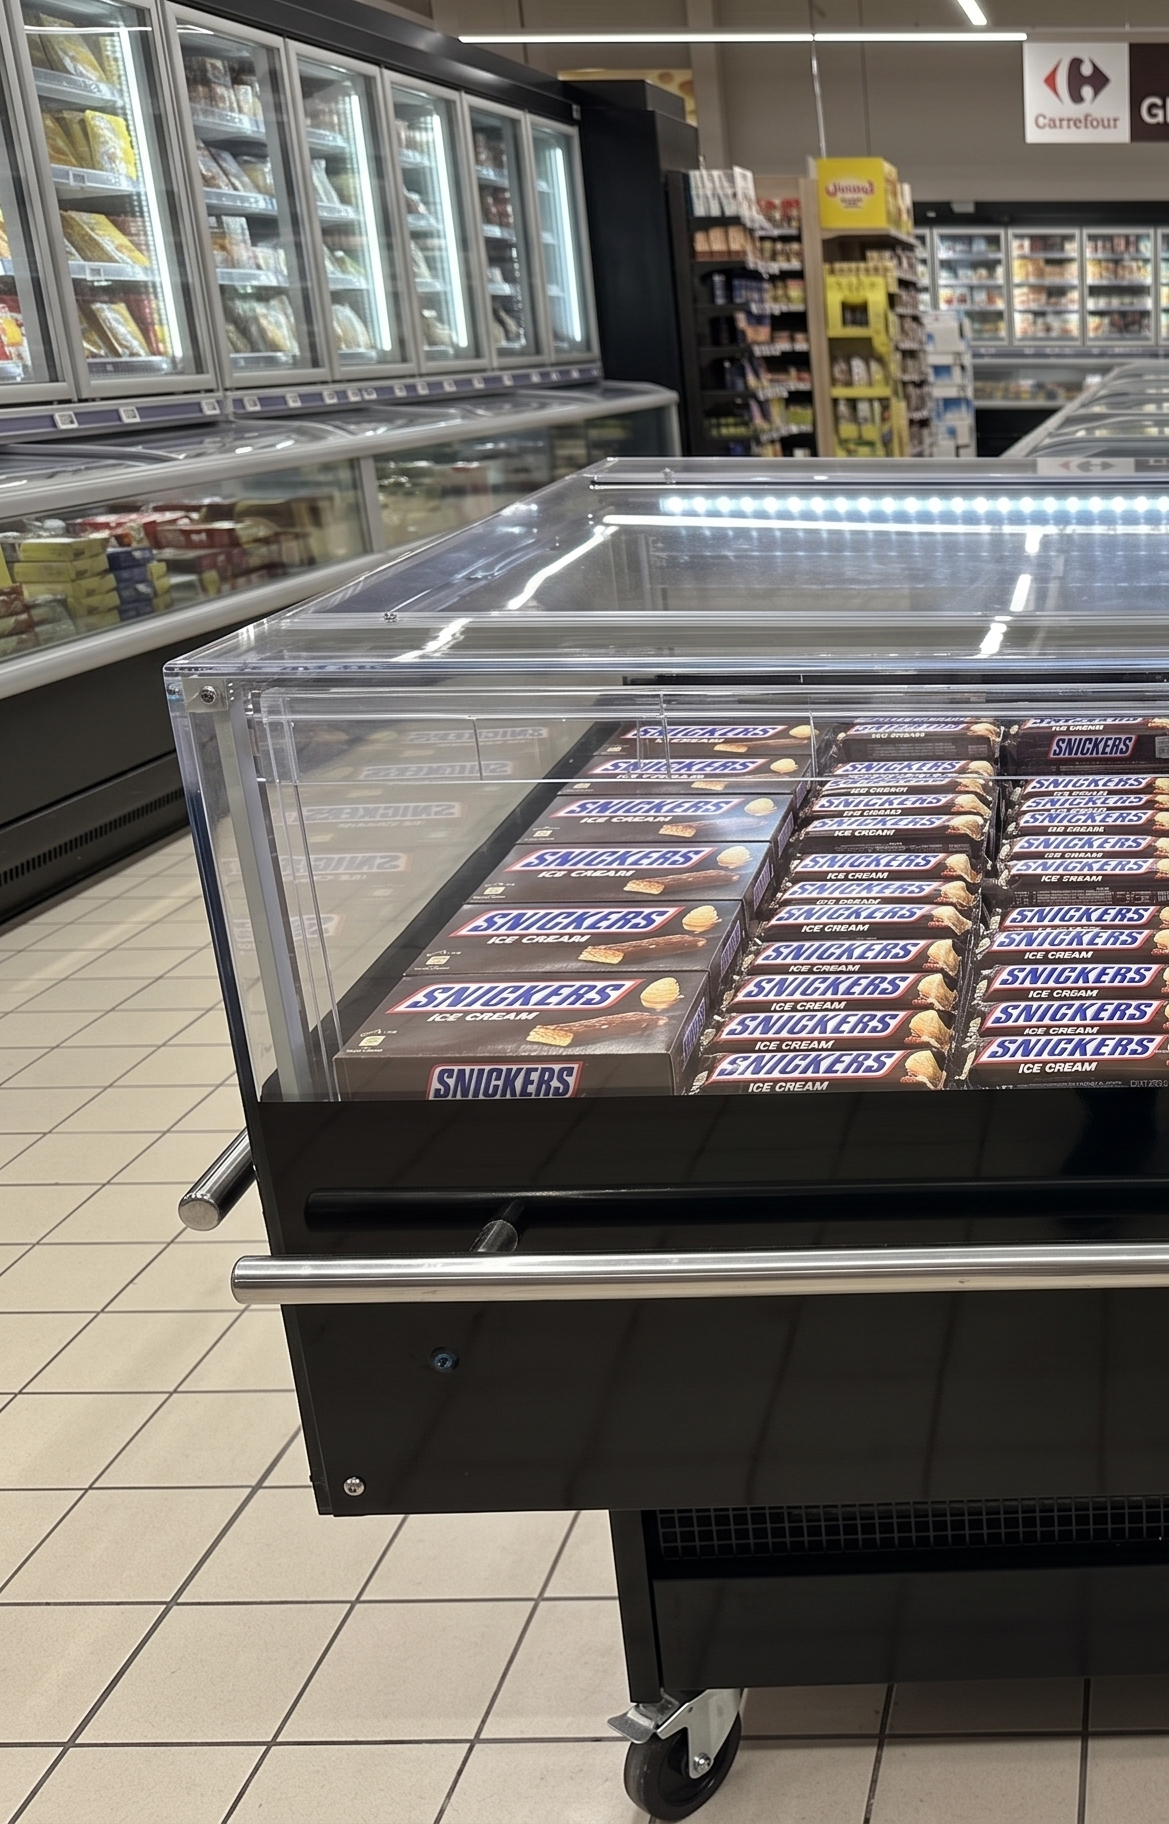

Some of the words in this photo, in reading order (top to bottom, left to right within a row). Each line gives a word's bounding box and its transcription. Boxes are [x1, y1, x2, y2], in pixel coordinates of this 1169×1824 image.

[1034, 113, 1120, 130] Carrefour
[1052, 736, 1132, 757] SNICKERS
[842, 761, 960, 772] SNICKERS
[1031, 777, 1149, 789] SNICKERS
[567, 800, 731, 814] SNICKERS
[1023, 811, 1148, 824] SNICKERS
[1019, 836, 1149, 849] SNICKERS
[520, 850, 702, 868] SNICKERS
[800, 854, 940, 868] SNICKERS
[1017, 859, 1148, 872] SNICKERS
[789, 882, 933, 896] SNICKERS
[776, 905, 921, 921] SNICKERS
[1009, 907, 1150, 923] SNICKERS
[466, 911, 667, 932] SNICKERS
[825, 924, 869, 932] CREAM
[487, 936, 519, 944] ICE
[997, 931, 1144, 947] SNICKERS
[762, 942, 920, 961] SNICKERS
[1024, 951, 1043, 959] ICE
[1047, 951, 1093, 959] CREAM
[812, 964, 860, 972] CREAM
[1000, 966, 1152, 985] SNICKERS
[743, 976, 909, 997] SNICKERS
[404, 983, 622, 1008] SNICKERS
[1028, 990, 1050, 998] ICE
[771, 1002, 795, 1011] ICE
[797, 1001, 847, 1010] CREAM
[991, 1002, 1154, 1024] SNICKERS
[427, 1013, 464, 1022] ICE
[465, 1011, 540, 1021] CREAM
[726, 1014, 898, 1036] SNICKERS
[1048, 1027, 1099, 1035] CREAM
[755, 1041, 780, 1050] ICE
[783, 1040, 836, 1049] CREAM
[987, 1037, 1156, 1059] SNICKERS
[717, 1052, 895, 1077] SNICKERS
[1019, 1063, 1043, 1073] ICE
[1045, 1062, 1097, 1073] CREAM
[433, 1066, 575, 1099] SNICKERS
[748, 1083, 774, 1093] ICE
[776, 1081, 829, 1092] CREAM
